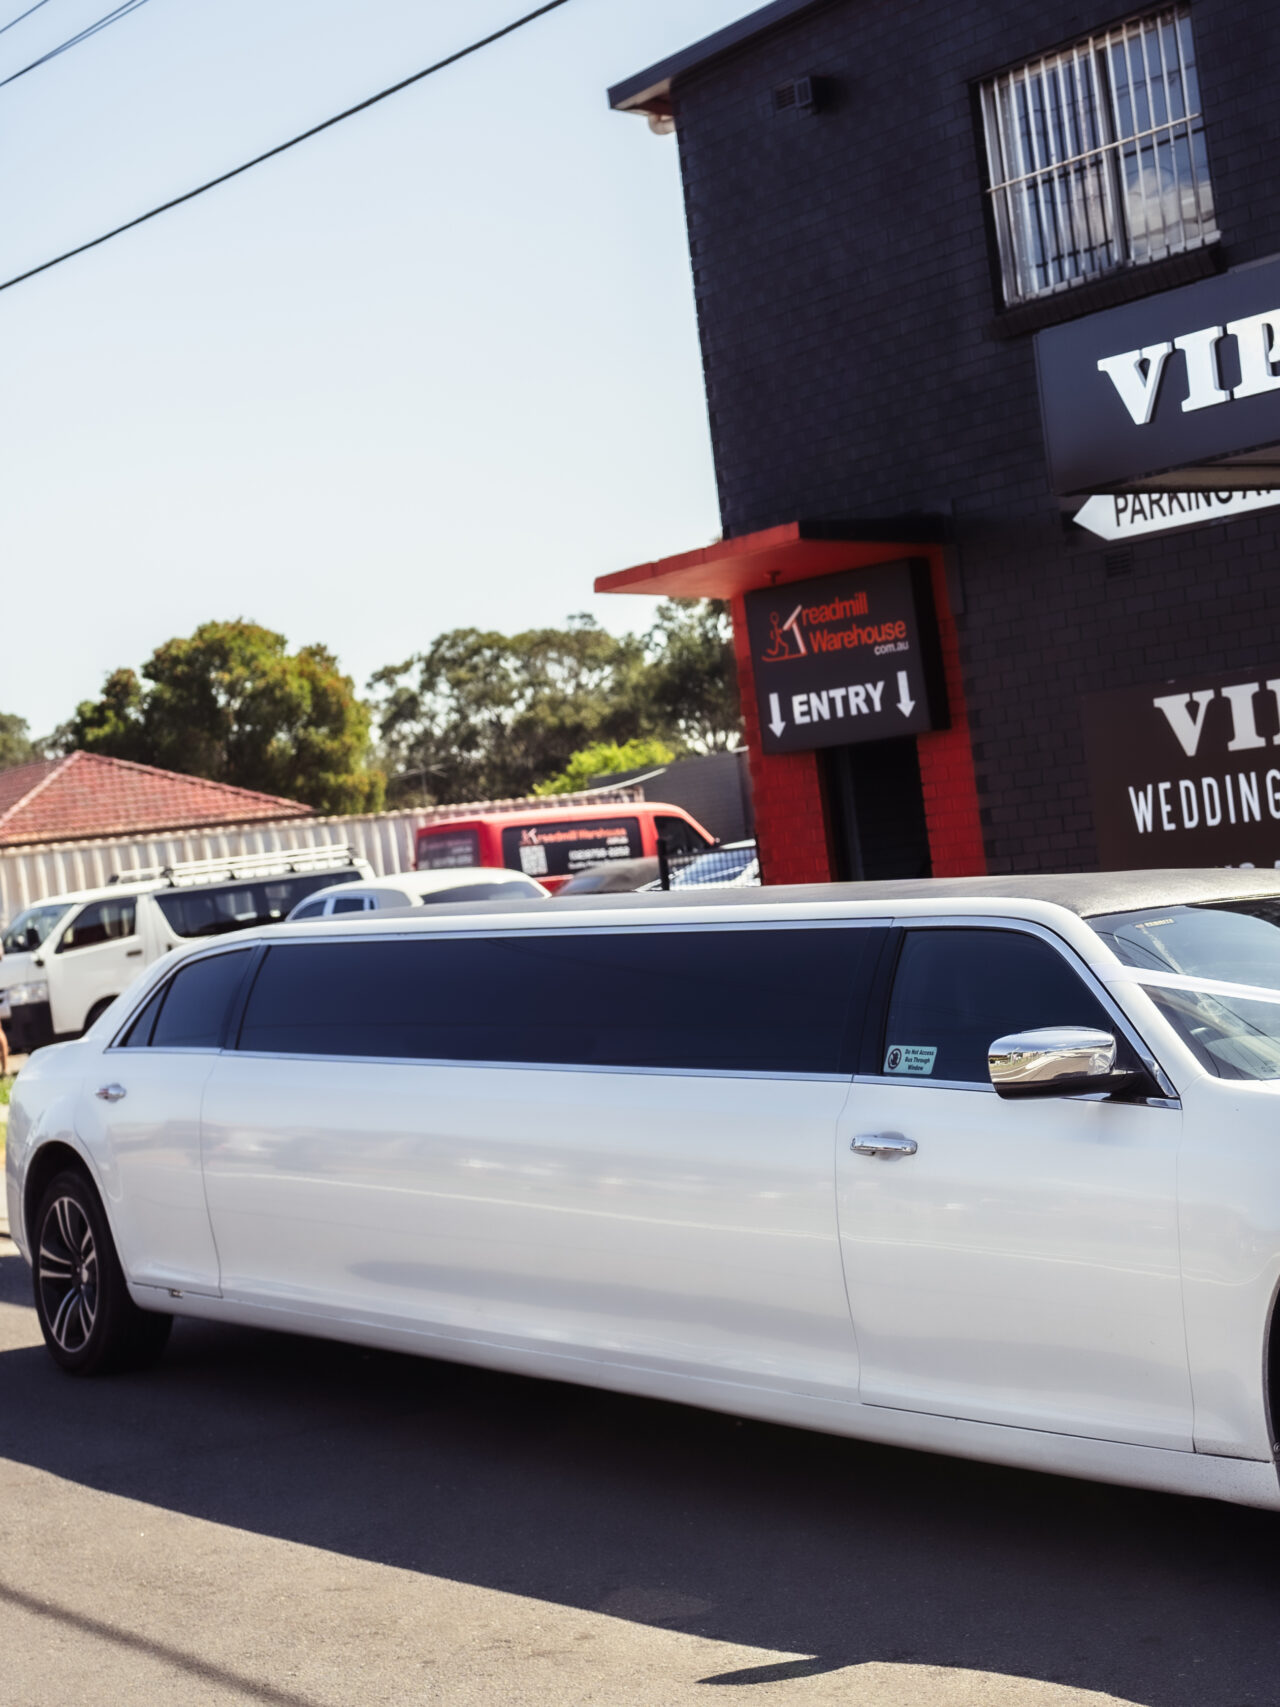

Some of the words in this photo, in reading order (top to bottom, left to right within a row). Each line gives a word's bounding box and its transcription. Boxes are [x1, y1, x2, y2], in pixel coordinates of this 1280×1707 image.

[809, 620, 907, 654] Warehouse
[874, 640, 909, 656] com.au
[792, 681, 885, 725] ENTRY
